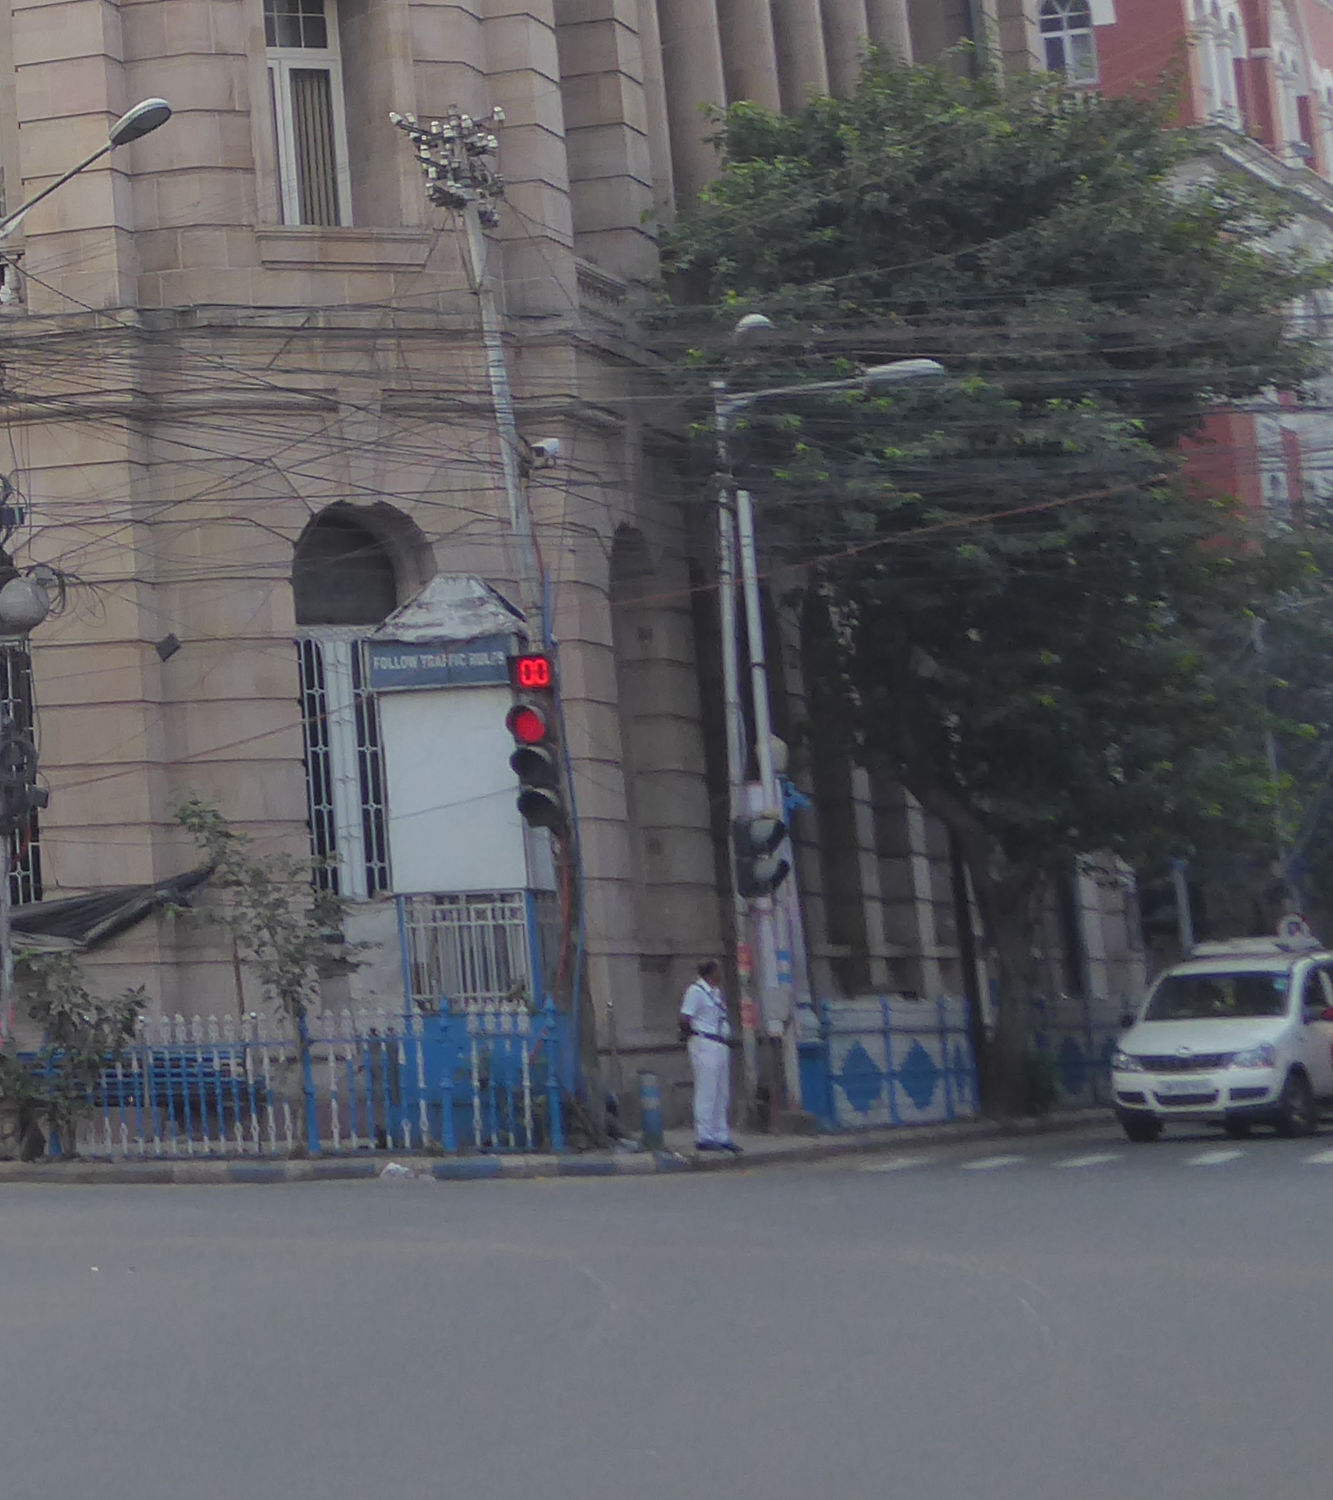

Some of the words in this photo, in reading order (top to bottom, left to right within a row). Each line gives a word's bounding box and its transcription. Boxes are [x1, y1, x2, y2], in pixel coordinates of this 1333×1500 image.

[373, 655, 417, 670] FOLLOW
[421, 653, 466, 668] TRAFFIC
[469, 651, 505, 666] RULES
[520, 658, 549, 685] 00
